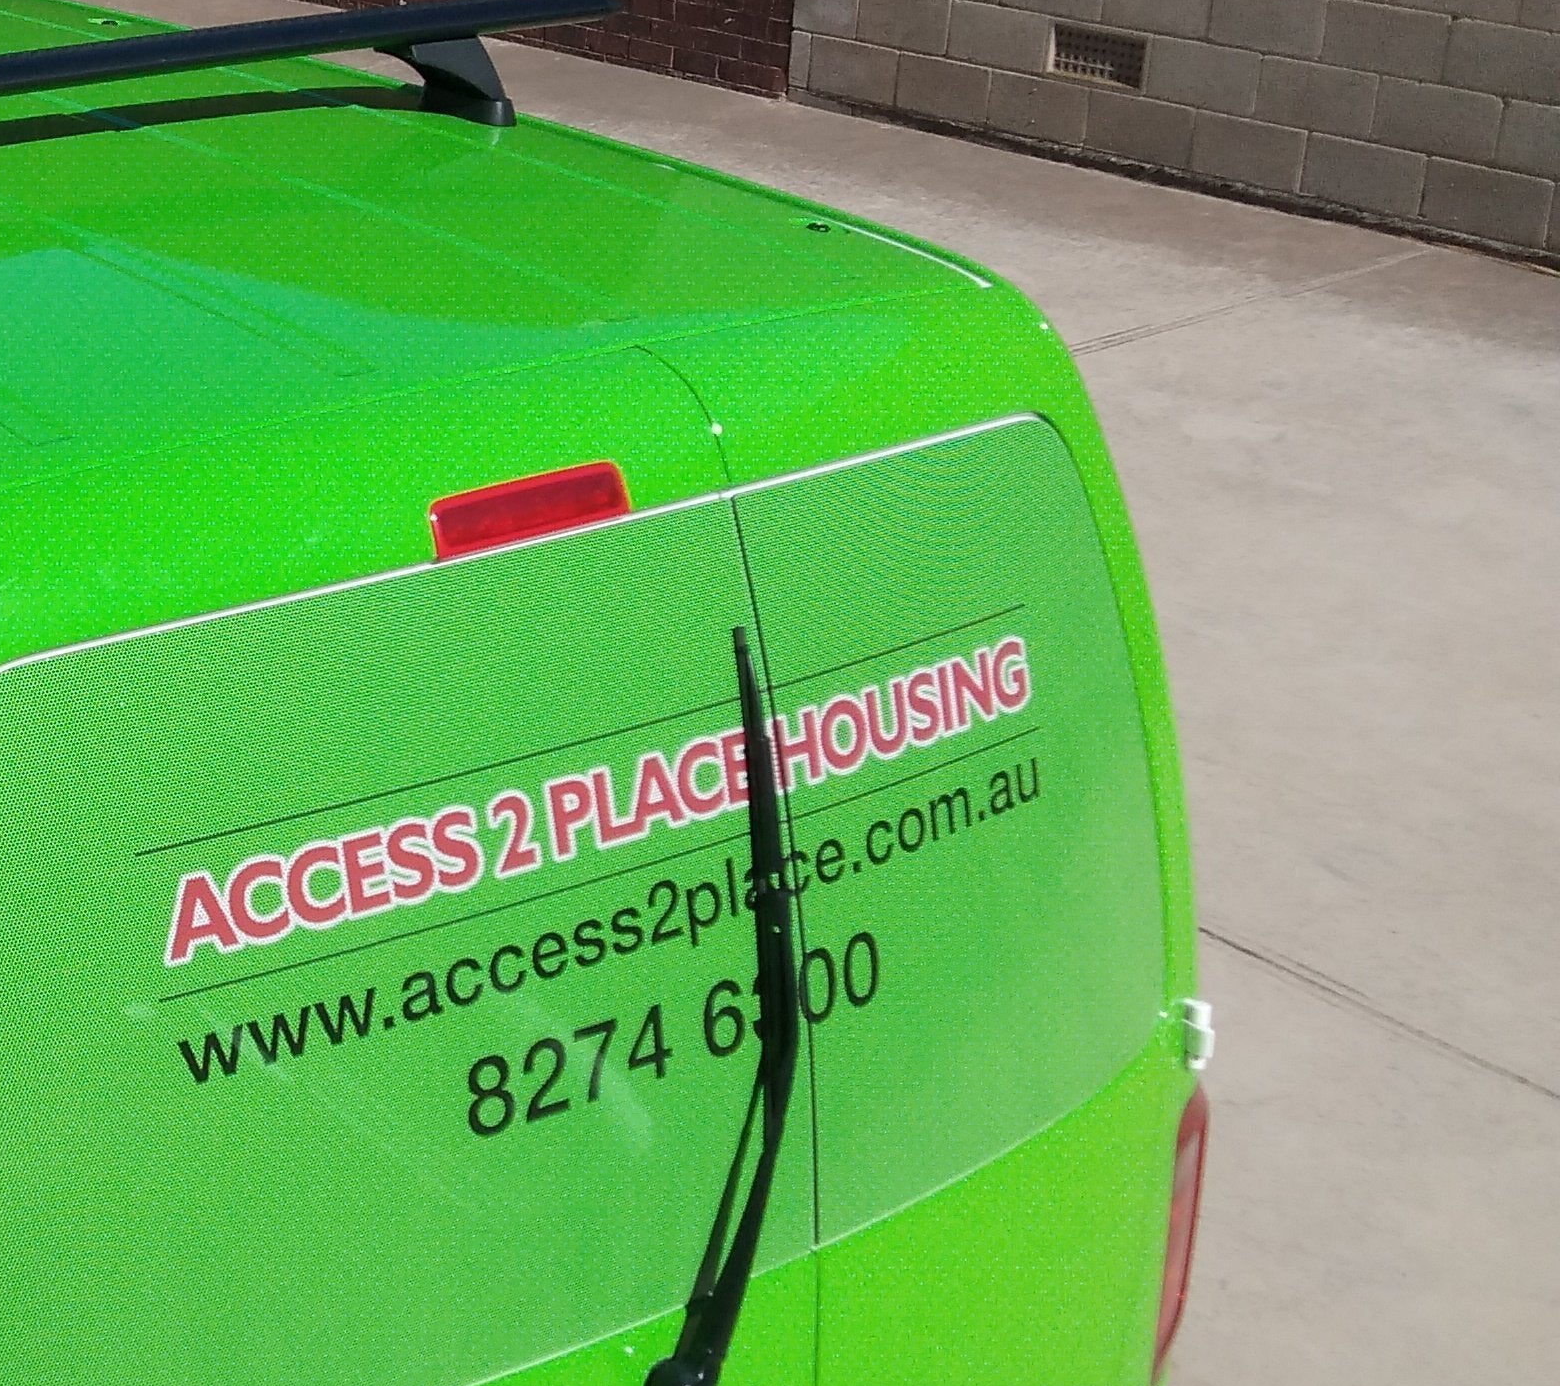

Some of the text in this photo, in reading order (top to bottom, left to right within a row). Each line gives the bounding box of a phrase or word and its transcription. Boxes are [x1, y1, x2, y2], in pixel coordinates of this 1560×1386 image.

[163, 635, 1032, 968] ACCESS 2 PLACE HOUSING
[466, 932, 880, 1137] 8274 600
